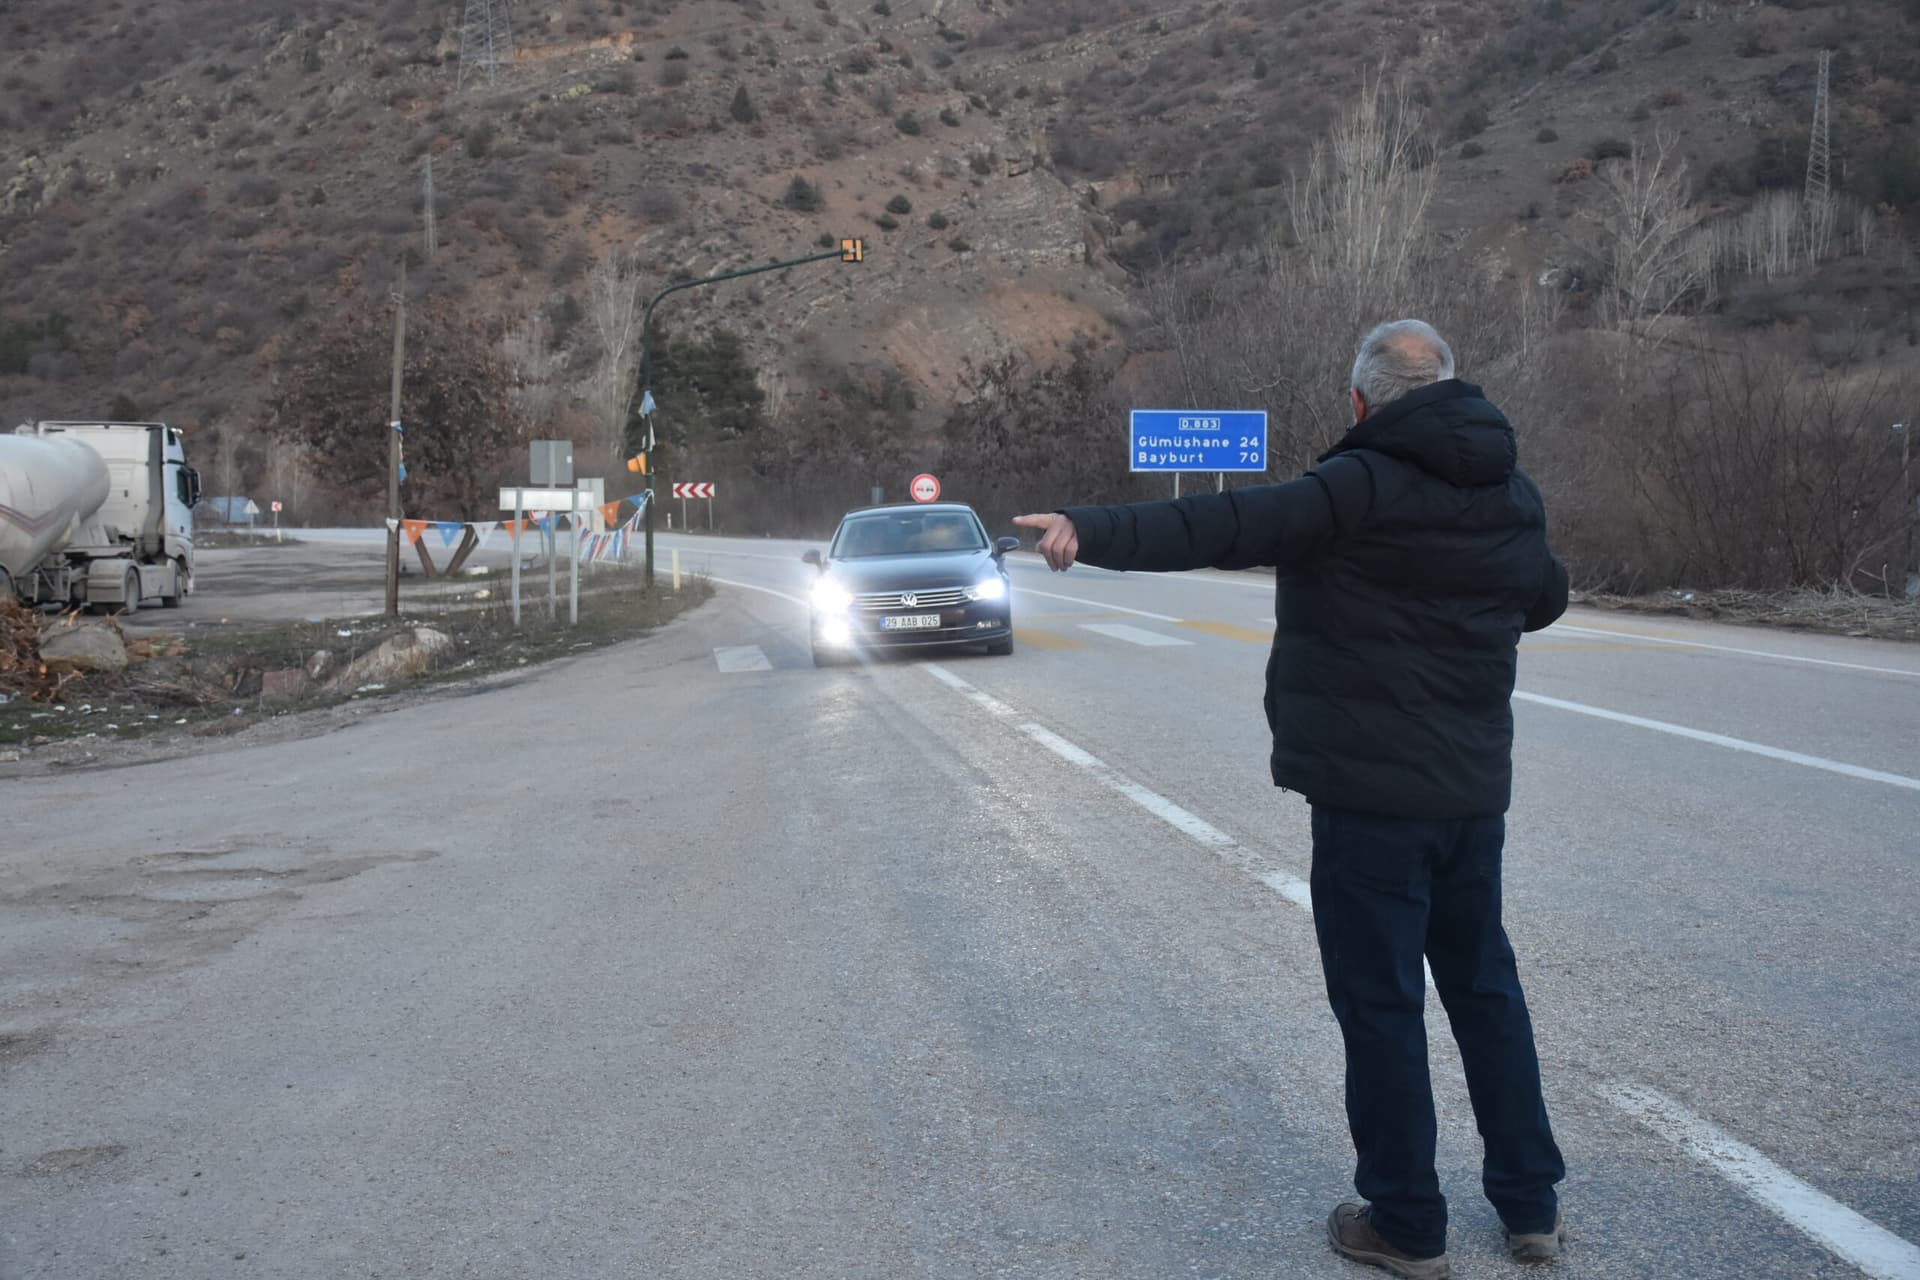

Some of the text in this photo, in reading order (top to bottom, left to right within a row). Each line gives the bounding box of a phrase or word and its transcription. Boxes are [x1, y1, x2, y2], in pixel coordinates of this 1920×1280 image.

[1138, 436, 1259, 448] Gümüşhane 24
[1138, 452, 1259, 465] Bayburt 70
[901, 617, 918, 626] AAB
[921, 615, 938, 626] 025
